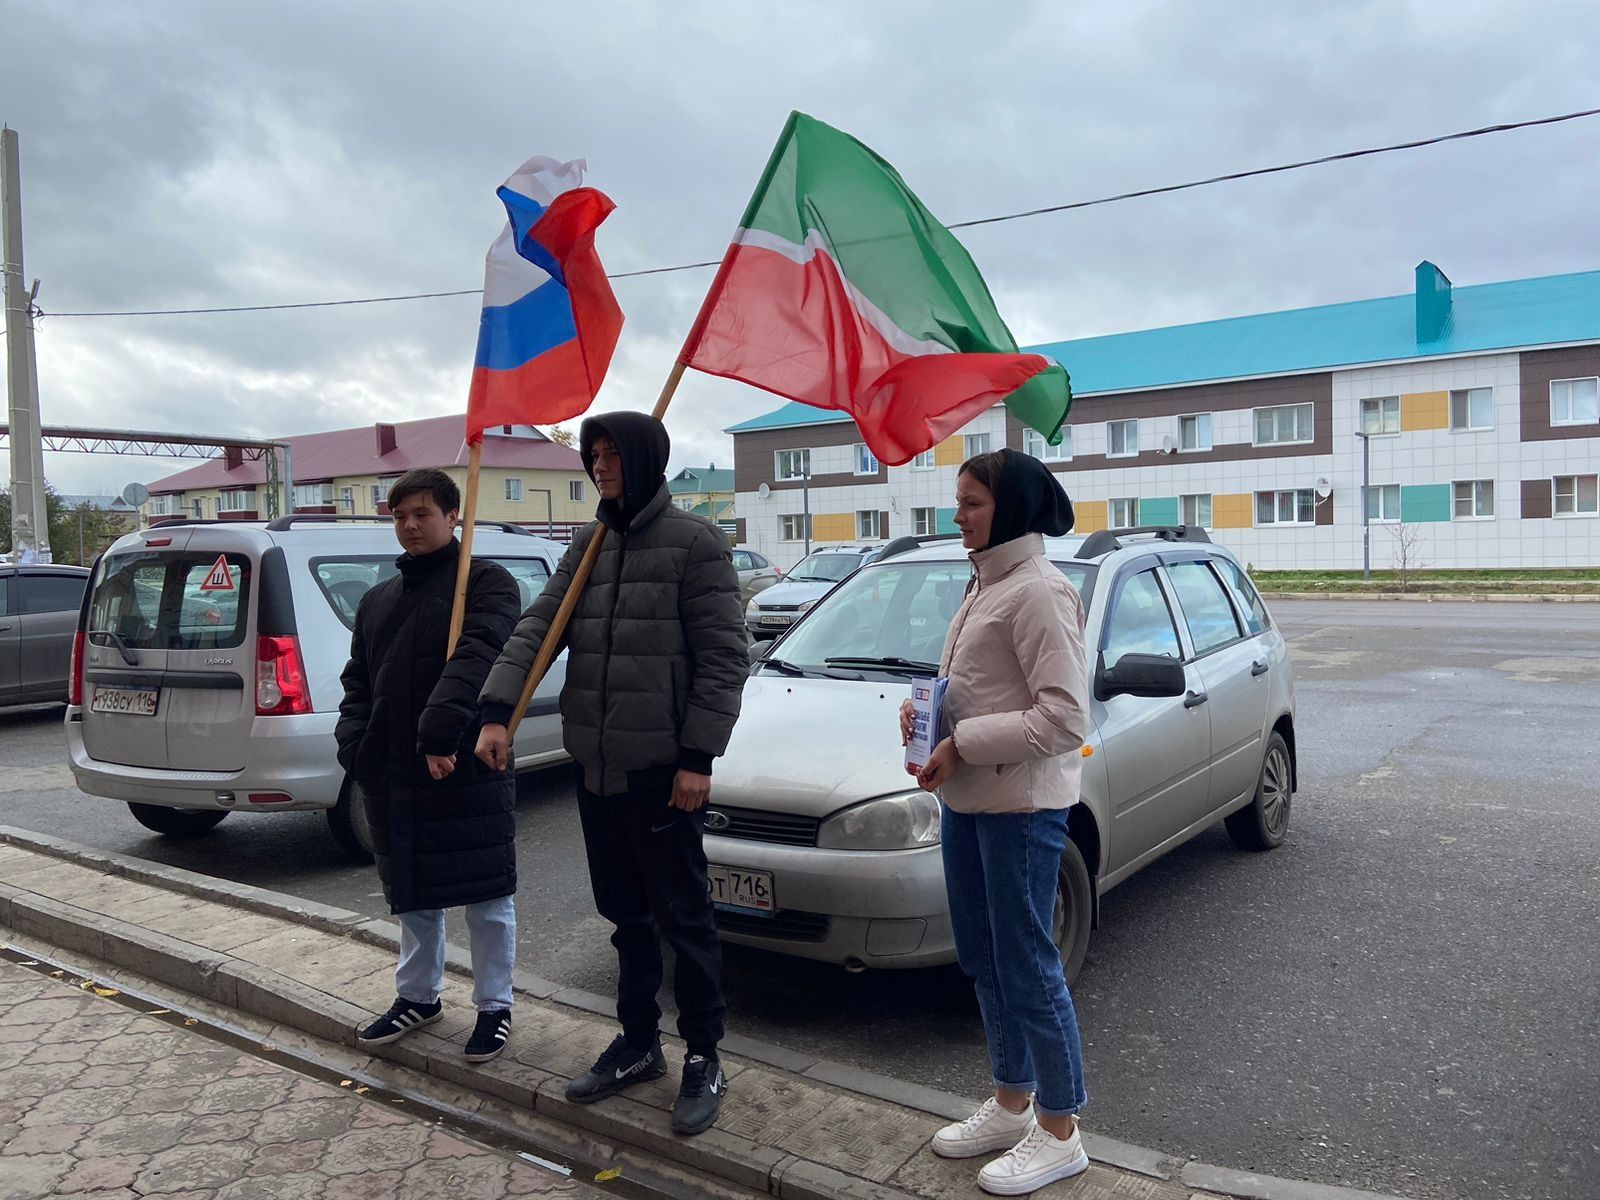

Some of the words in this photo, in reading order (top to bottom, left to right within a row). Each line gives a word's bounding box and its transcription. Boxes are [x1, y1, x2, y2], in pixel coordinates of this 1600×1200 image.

[212, 573, 224, 584] Ш
[731, 873, 765, 897] 716
[739, 894, 756, 904] RUS
